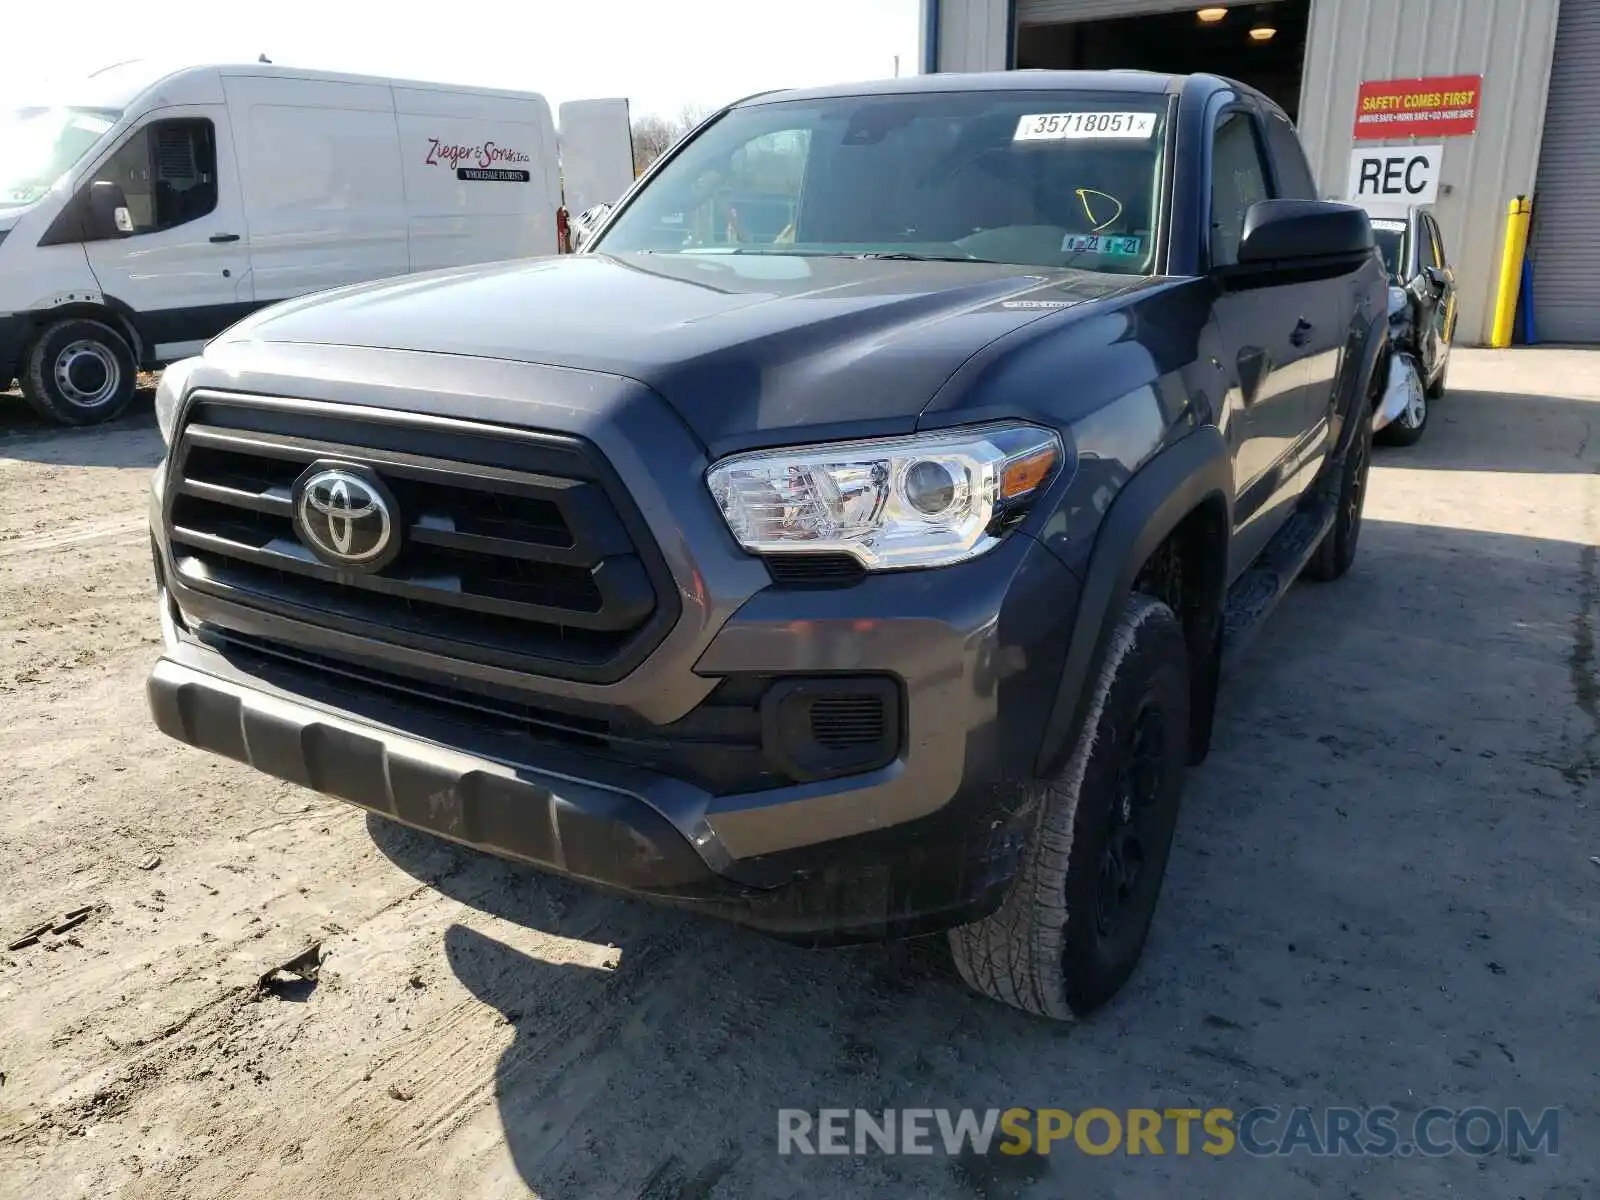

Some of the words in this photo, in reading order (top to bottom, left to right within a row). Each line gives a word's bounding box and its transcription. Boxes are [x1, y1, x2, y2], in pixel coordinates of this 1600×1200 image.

[1362, 95, 1402, 111] SAFETY
[1404, 93, 1441, 108] COMES
[1443, 90, 1475, 106] FIRST
[1034, 114, 1134, 133] 35718051
[425, 137, 473, 170] Zieger
[1358, 155, 1430, 194] REC
